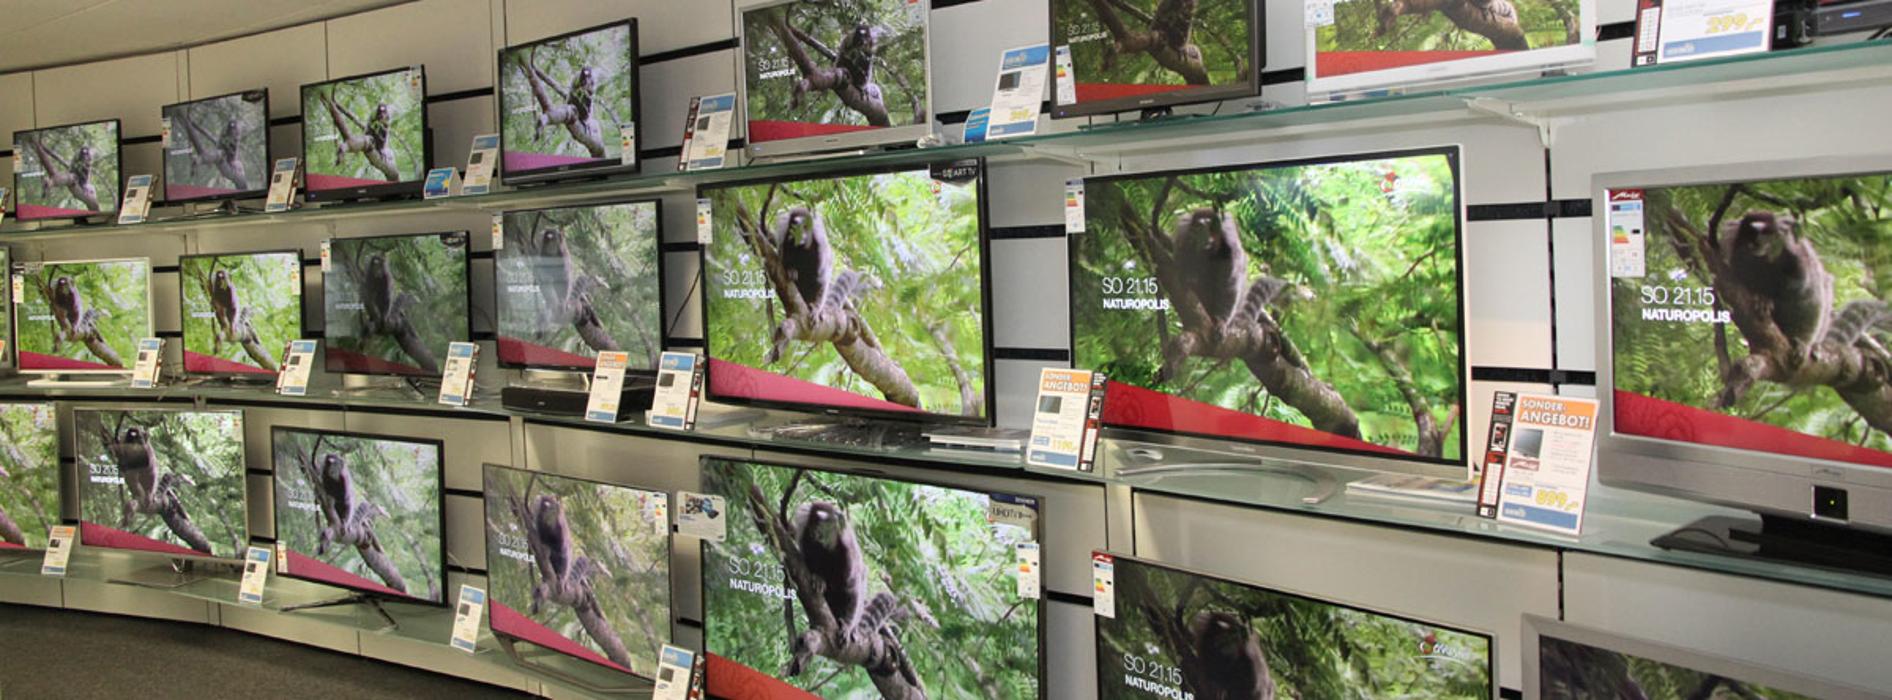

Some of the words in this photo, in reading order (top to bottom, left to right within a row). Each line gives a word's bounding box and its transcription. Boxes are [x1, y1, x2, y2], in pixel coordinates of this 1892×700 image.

[1102, 276, 1123, 295] SO
[1126, 276, 1158, 295] 21.15
[1640, 284, 1669, 305] SO
[1672, 286, 1715, 305] 21.15
[1103, 297, 1170, 311] NATUROPOLIS
[1642, 308, 1731, 323] NATUROPOLIS
[1520, 411, 1591, 428] ANGEBOT!
[728, 555, 750, 576] SO
[754, 560, 785, 582] 21.15
[729, 578, 797, 600] NATUROPOLIS
[1123, 652, 1145, 674] SO
[1149, 661, 1183, 685] 21.15
[1125, 674, 1195, 700] NATUROPOLIS
